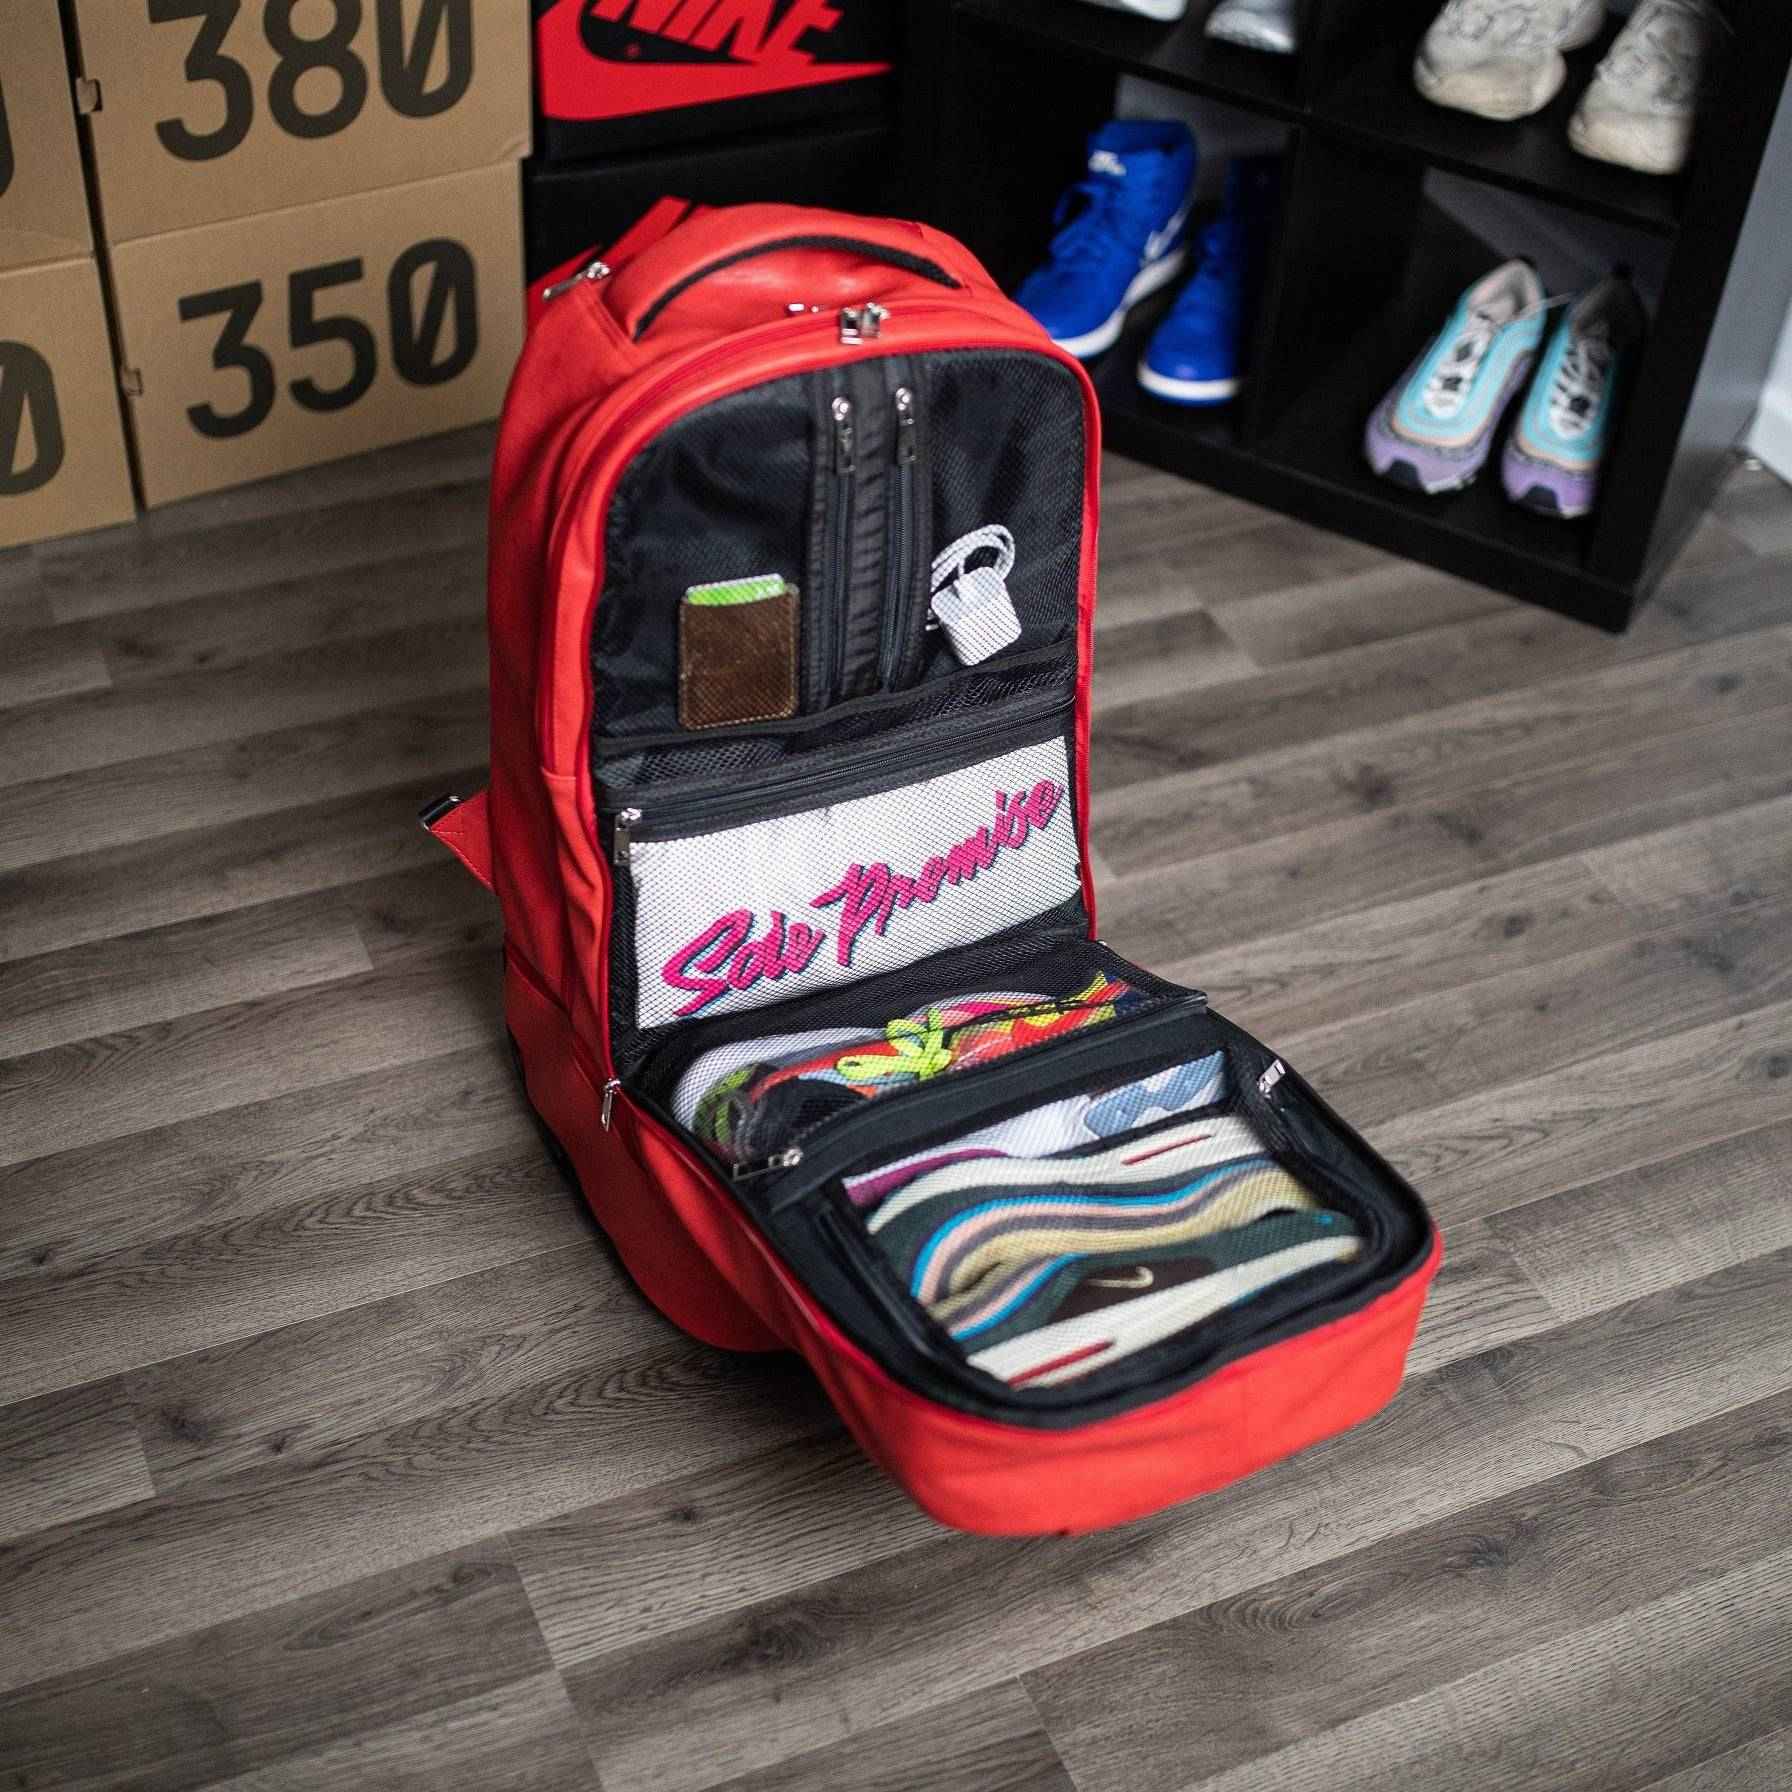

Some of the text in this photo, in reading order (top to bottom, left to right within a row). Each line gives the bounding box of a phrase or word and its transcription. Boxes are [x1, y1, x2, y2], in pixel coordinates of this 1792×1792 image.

[147, 0, 474, 162] 380
[177, 238, 481, 442] 350
[661, 778, 1065, 1018] Sole Promise
